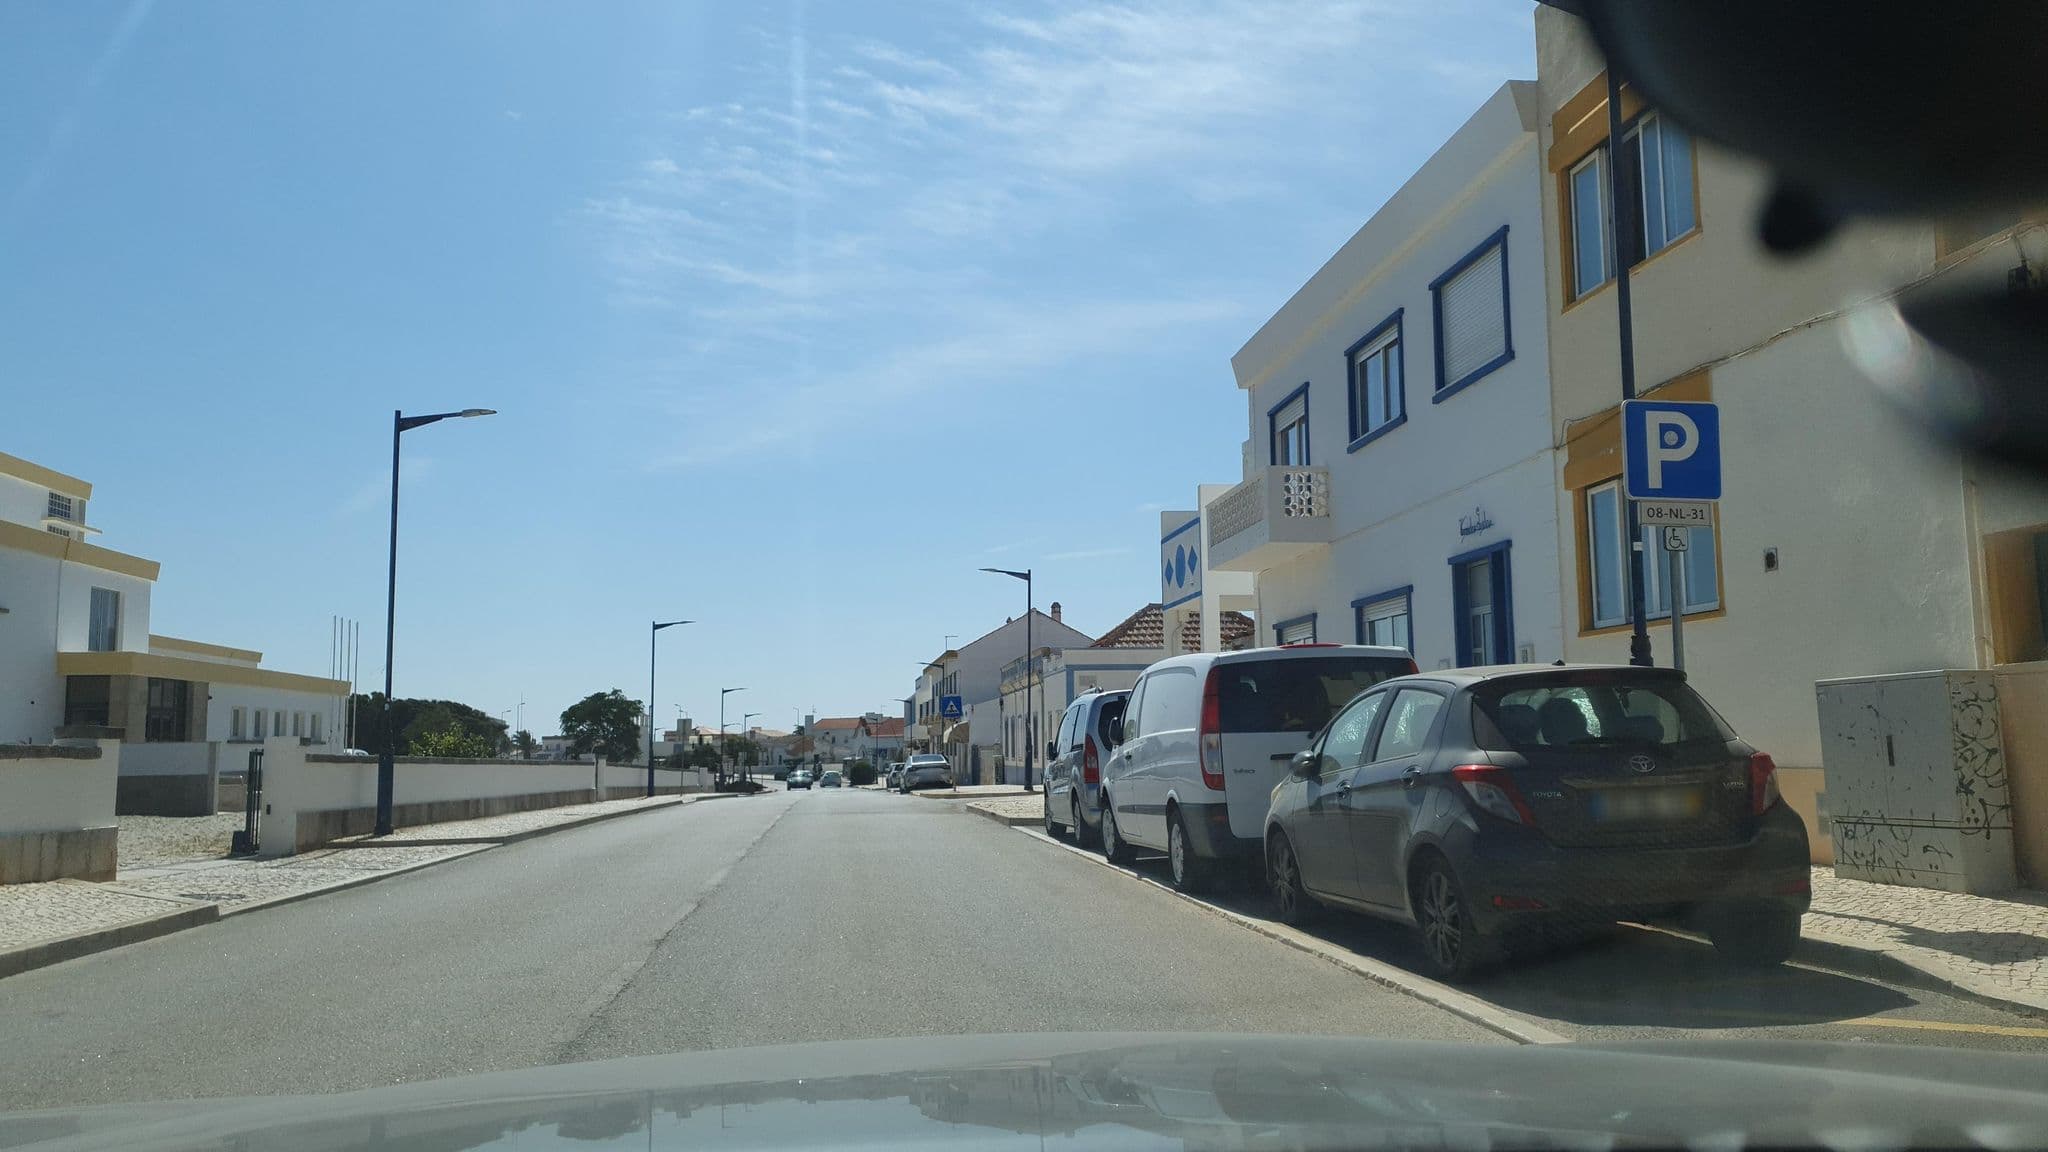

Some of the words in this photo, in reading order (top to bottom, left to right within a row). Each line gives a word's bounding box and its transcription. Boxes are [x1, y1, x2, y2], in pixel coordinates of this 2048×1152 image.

[1645, 410, 1700, 489] P
[1646, 507, 1705, 520] 08-NL-31
[1532, 791, 1564, 800] TOYOTA
